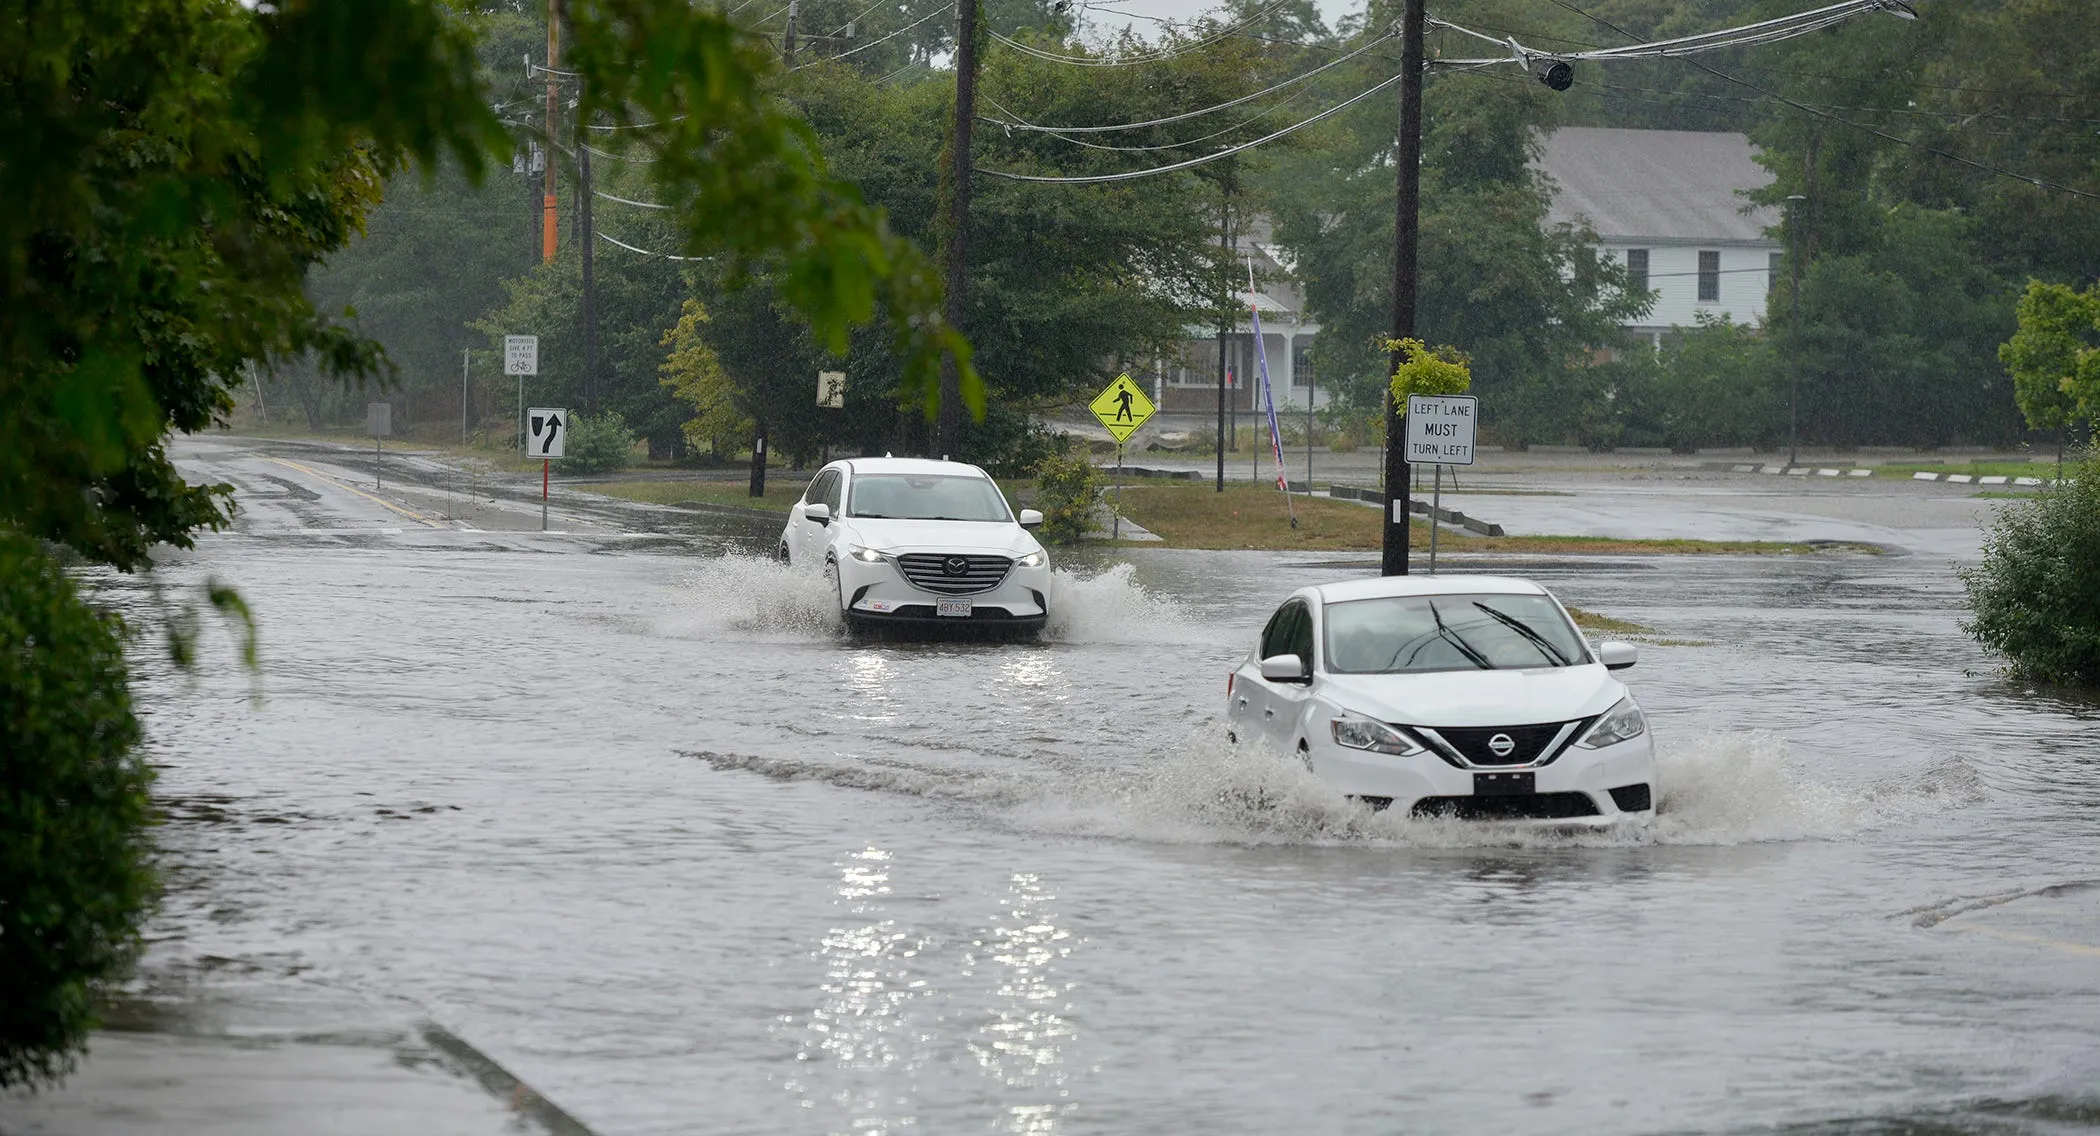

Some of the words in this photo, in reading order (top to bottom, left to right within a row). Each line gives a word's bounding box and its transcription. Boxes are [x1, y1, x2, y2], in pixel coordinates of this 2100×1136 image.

[1414, 404, 1439, 414] LEFT
[1444, 405, 1470, 416] LANE
[1425, 423, 1457, 437] MUST
[1413, 443, 1438, 454] TURN
[1443, 445, 1468, 456] LEFT
[955, 604, 970, 612] 532
